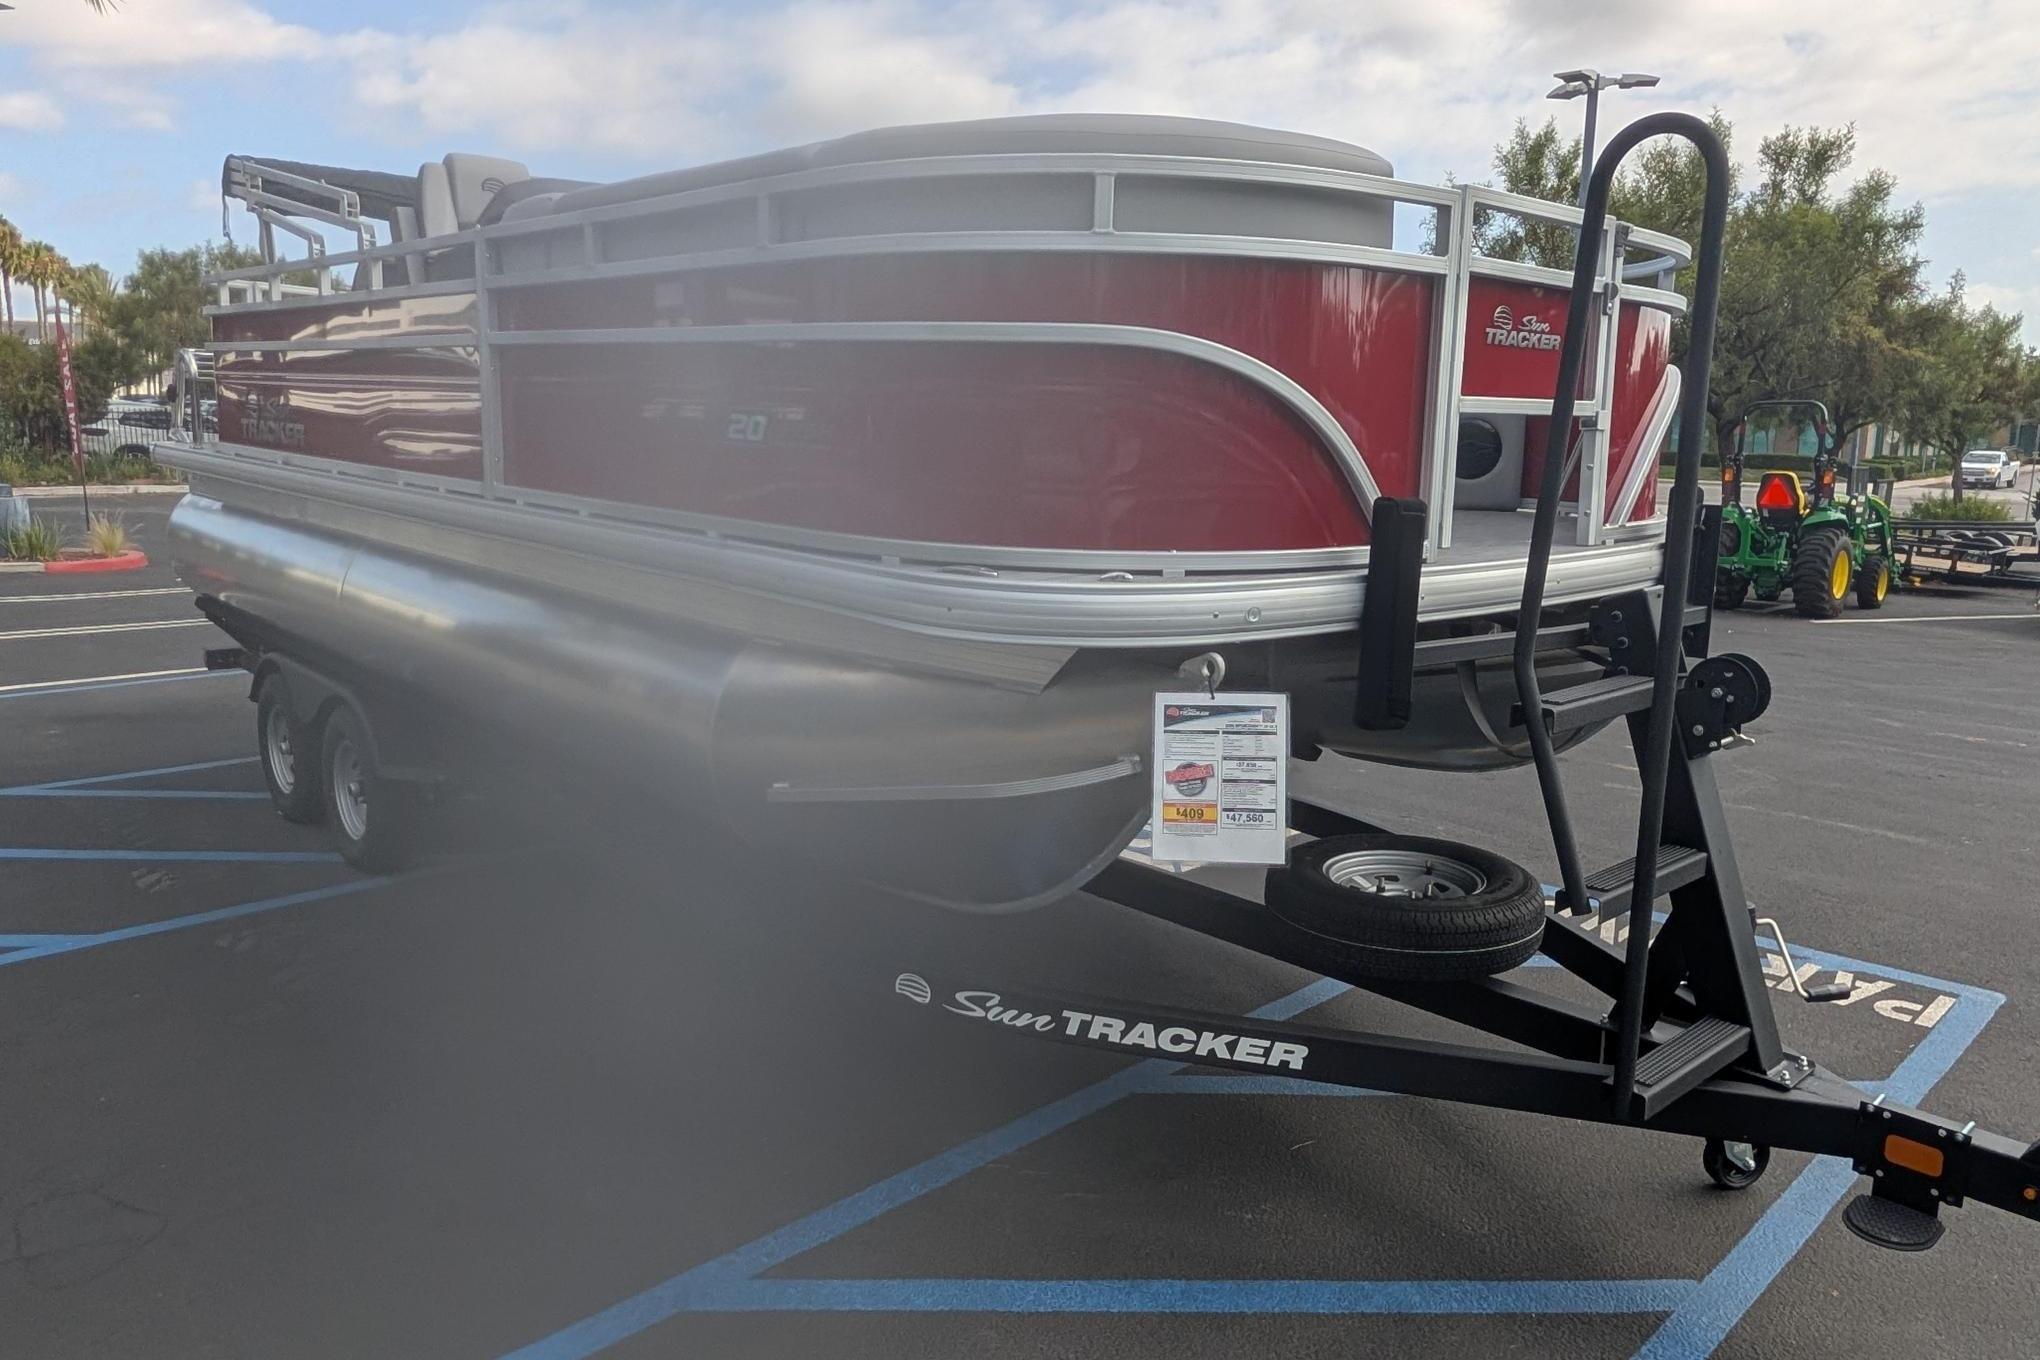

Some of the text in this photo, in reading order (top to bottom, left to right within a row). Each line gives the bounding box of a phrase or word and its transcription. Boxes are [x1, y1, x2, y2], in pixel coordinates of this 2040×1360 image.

[1518, 315, 1551, 332] Sun
[1485, 328, 1561, 350] TRACKER
[728, 412, 768, 442] 20
[1176, 807, 1205, 820] $409
[942, 990, 1310, 1070] Sun TRACKER
